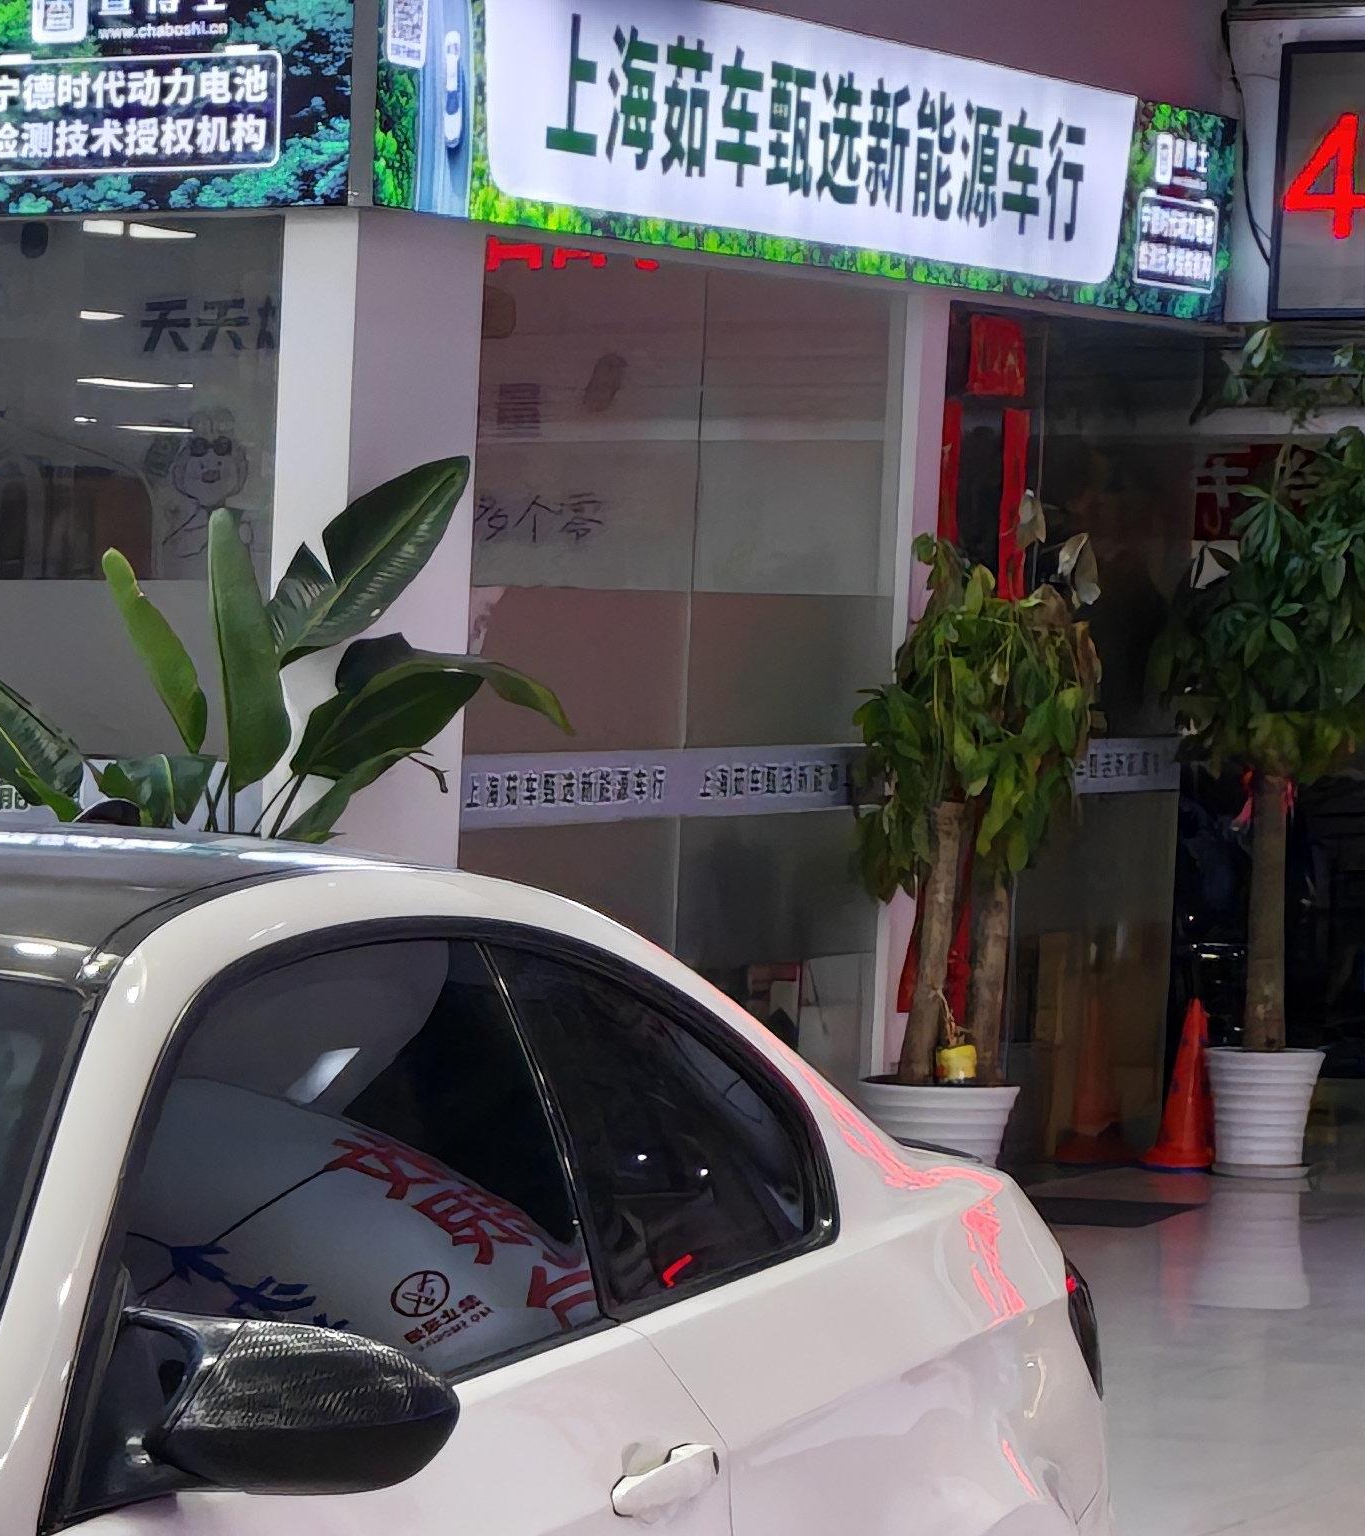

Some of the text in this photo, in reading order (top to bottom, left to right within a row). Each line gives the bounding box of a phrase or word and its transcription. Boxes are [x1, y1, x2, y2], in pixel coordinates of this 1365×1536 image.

[98, 20, 228, 40] www.chaboshi.cn
[546, 13, 1087, 242] 上海茹车甄选新能源车行
